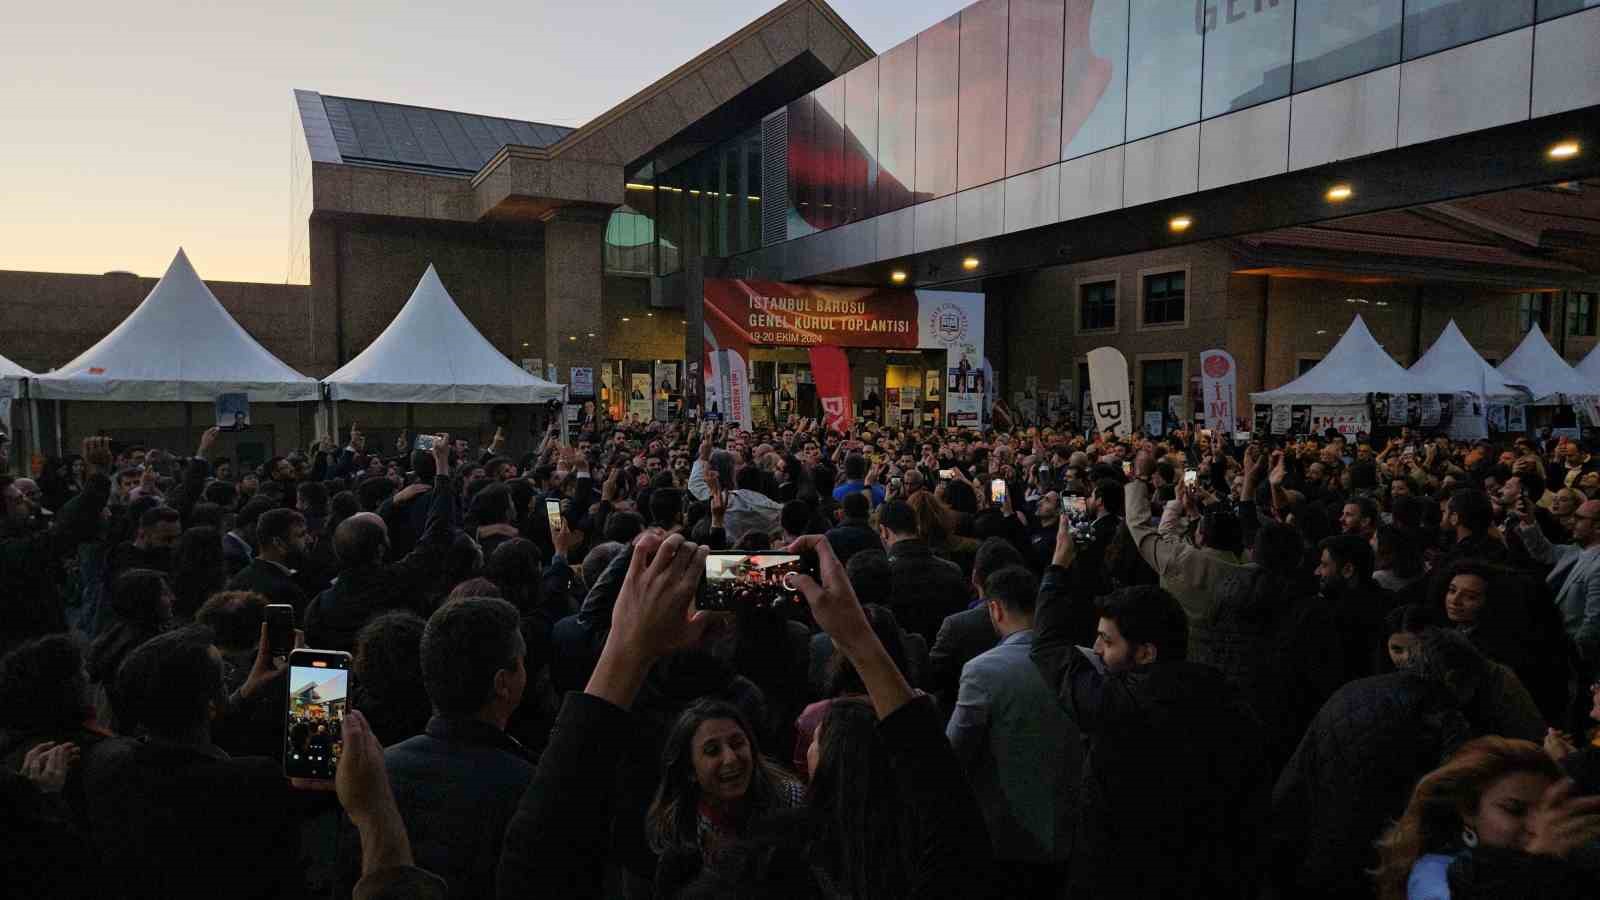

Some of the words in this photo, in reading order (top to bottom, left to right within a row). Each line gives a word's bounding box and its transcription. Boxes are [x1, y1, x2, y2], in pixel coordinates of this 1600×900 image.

[816, 299, 865, 314] BAROSU
[749, 313, 790, 328] GENEL
[794, 315, 835, 330] KURUL
[841, 318, 909, 333] TOPLANTISI
[801, 334, 823, 344] 2024
